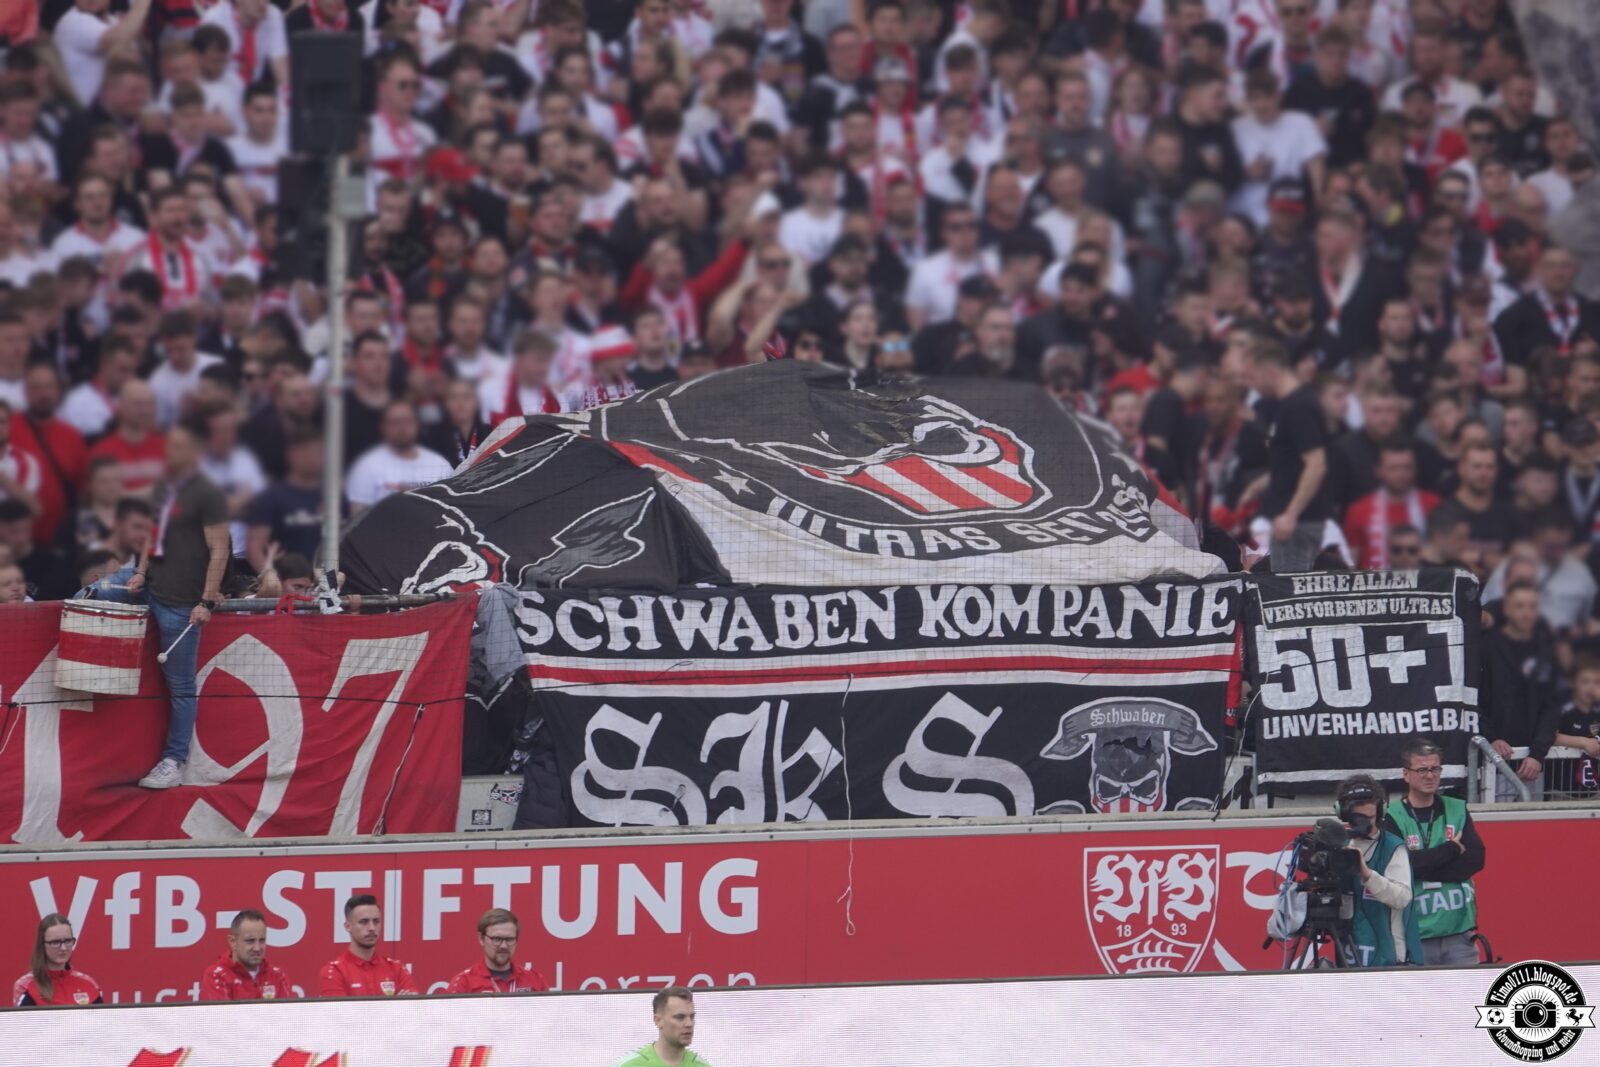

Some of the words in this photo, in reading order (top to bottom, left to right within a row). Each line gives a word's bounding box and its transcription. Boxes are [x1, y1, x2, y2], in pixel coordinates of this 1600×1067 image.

[1291, 575, 1350, 595] EHRE
[1352, 569, 1418, 592] ALLEN
[514, 585, 900, 651] SCHWABEN
[915, 578, 1243, 641] KOMPANIE
[1264, 598, 1387, 624] VERSTORBENEN
[1388, 597, 1453, 616] ULTRAS
[1255, 616, 1479, 711] 50+1
[1090, 707, 1165, 727] Schwaben
[30, 857, 759, 950] VfB-STIFTUNG
[1116, 924, 1132, 938] 18
[1171, 922, 1187, 936] 93
